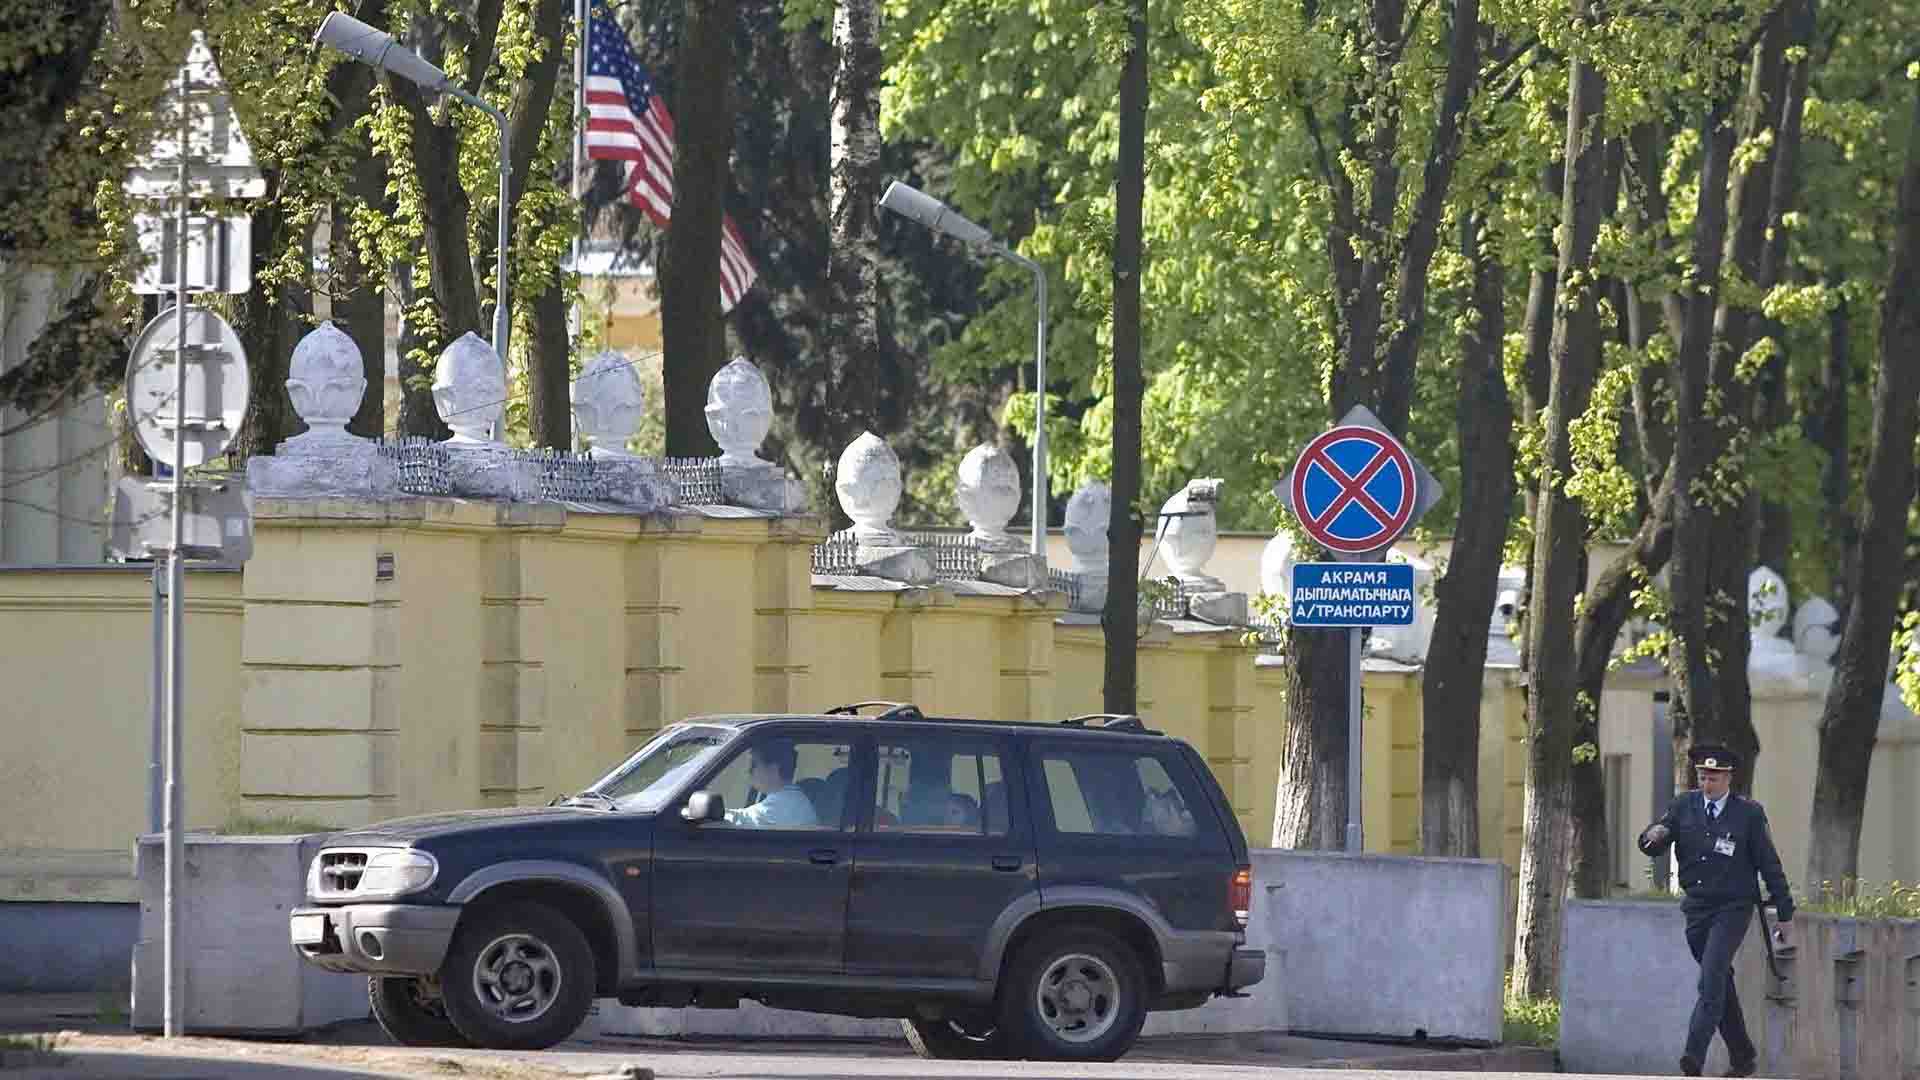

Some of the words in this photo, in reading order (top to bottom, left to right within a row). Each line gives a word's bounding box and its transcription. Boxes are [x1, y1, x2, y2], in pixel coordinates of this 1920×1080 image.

[1321, 571, 1387, 584] АКРАМЯ
[1294, 587, 1412, 602] ДЫПЛАМАТЫЧНАГА
[1296, 604, 1410, 618] А/ТРАНСПАРТУ
